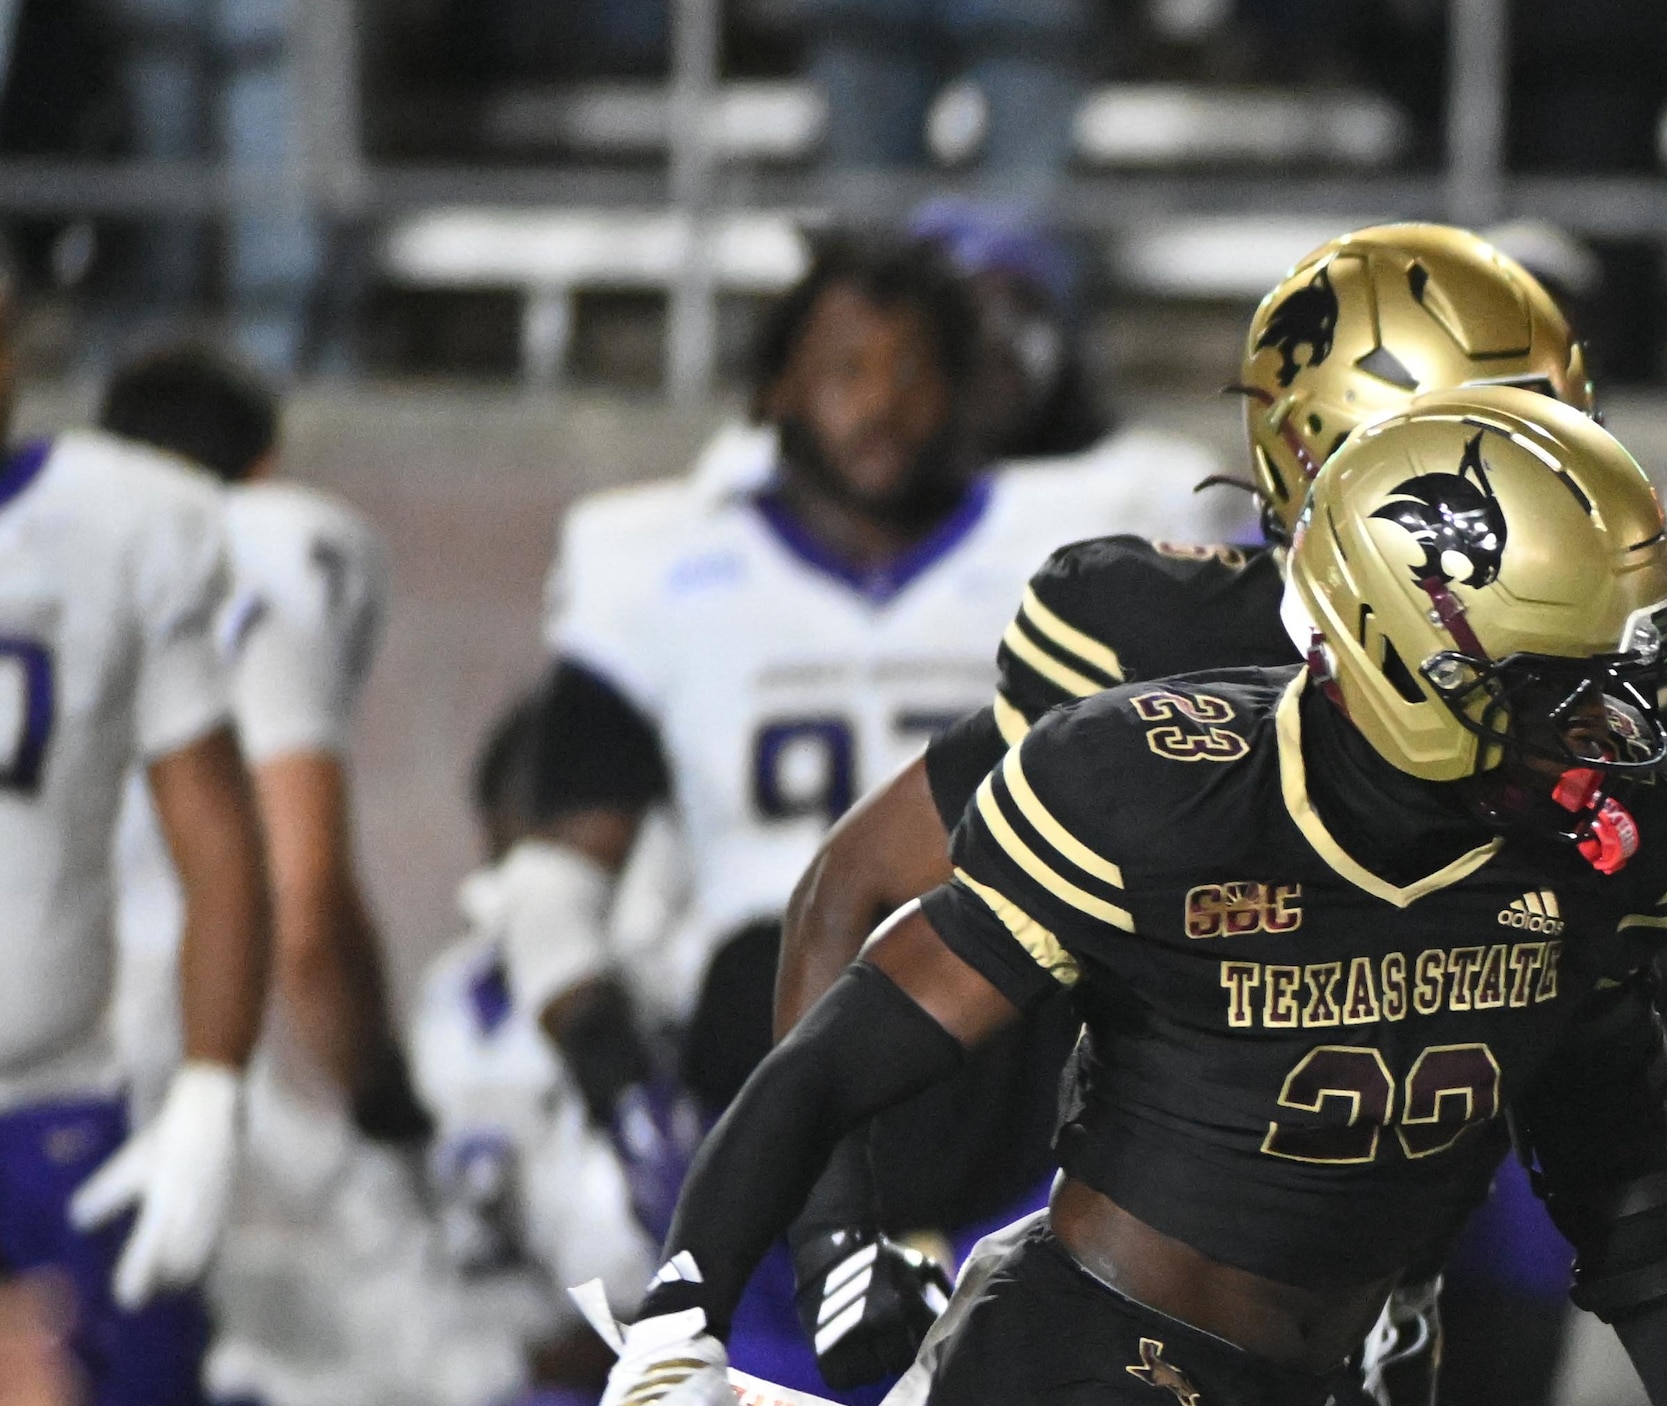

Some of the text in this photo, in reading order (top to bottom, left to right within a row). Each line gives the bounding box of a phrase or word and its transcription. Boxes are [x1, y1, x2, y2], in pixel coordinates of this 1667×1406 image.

[1129, 690, 1251, 762] 23
[1184, 881, 1303, 940] SBC
[1497, 908, 1566, 936] adidas
[1220, 939, 1563, 1029] TEXAS STATE
